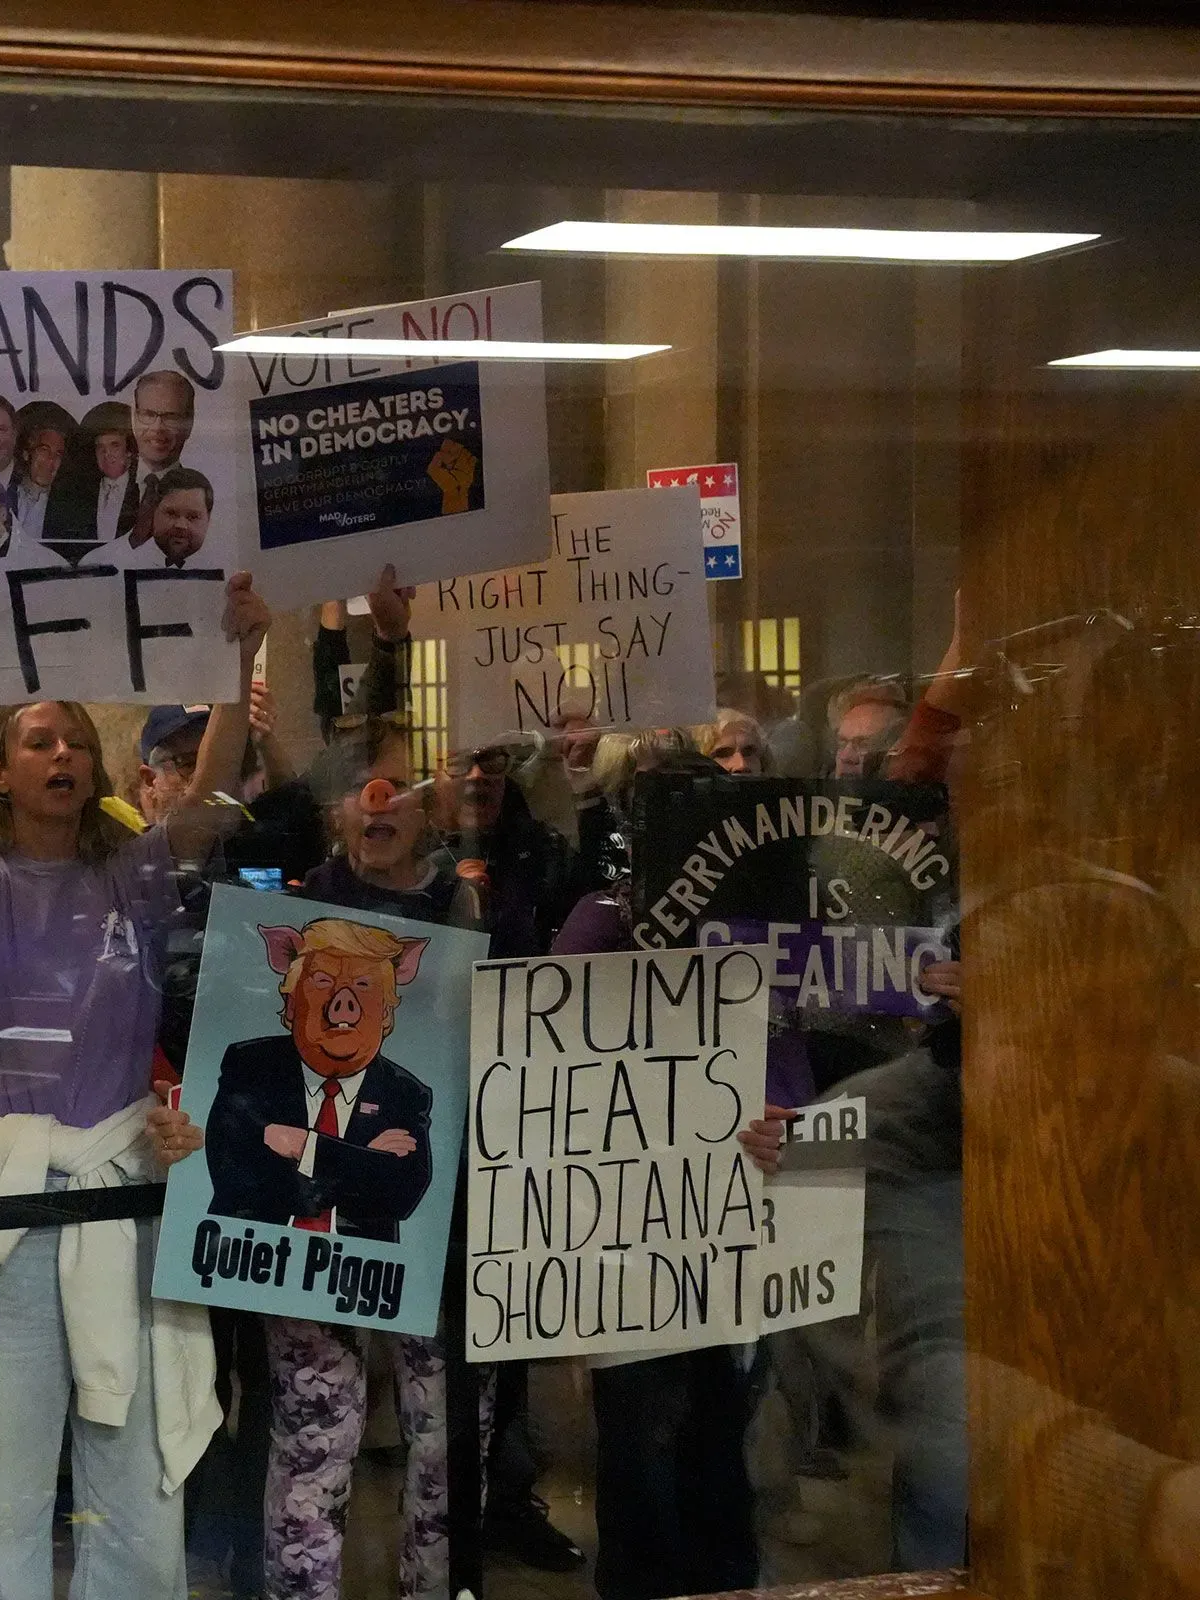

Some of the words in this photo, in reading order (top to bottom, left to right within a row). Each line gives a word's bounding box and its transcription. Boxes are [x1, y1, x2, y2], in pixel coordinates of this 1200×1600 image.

[246, 318, 382, 396] VOTE
[258, 413, 300, 439] NO
[306, 388, 445, 431] CHEATERS
[260, 440, 292, 466] IN
[299, 408, 477, 459] DEMOCRACY.
[319, 511, 342, 523] MAD
[551, 513, 612, 555] THE
[711, 511, 736, 539] NO
[437, 570, 548, 612] RIGHT
[475, 622, 568, 667] JUST
[598, 611, 672, 660] SAY
[514, 662, 632, 735] NO!!
[633, 796, 949, 950] GERRYMANDERING
[808, 875, 852, 919] IS
[476, 950, 763, 1058] TRUMP
[476, 1048, 742, 1161] CHEATS
[471, 1152, 757, 1258] INDIANA
[191, 1219, 292, 1289] Quiet
[301, 1235, 406, 1320] Piggy
[472, 1242, 758, 1349] SHOULDN'T
